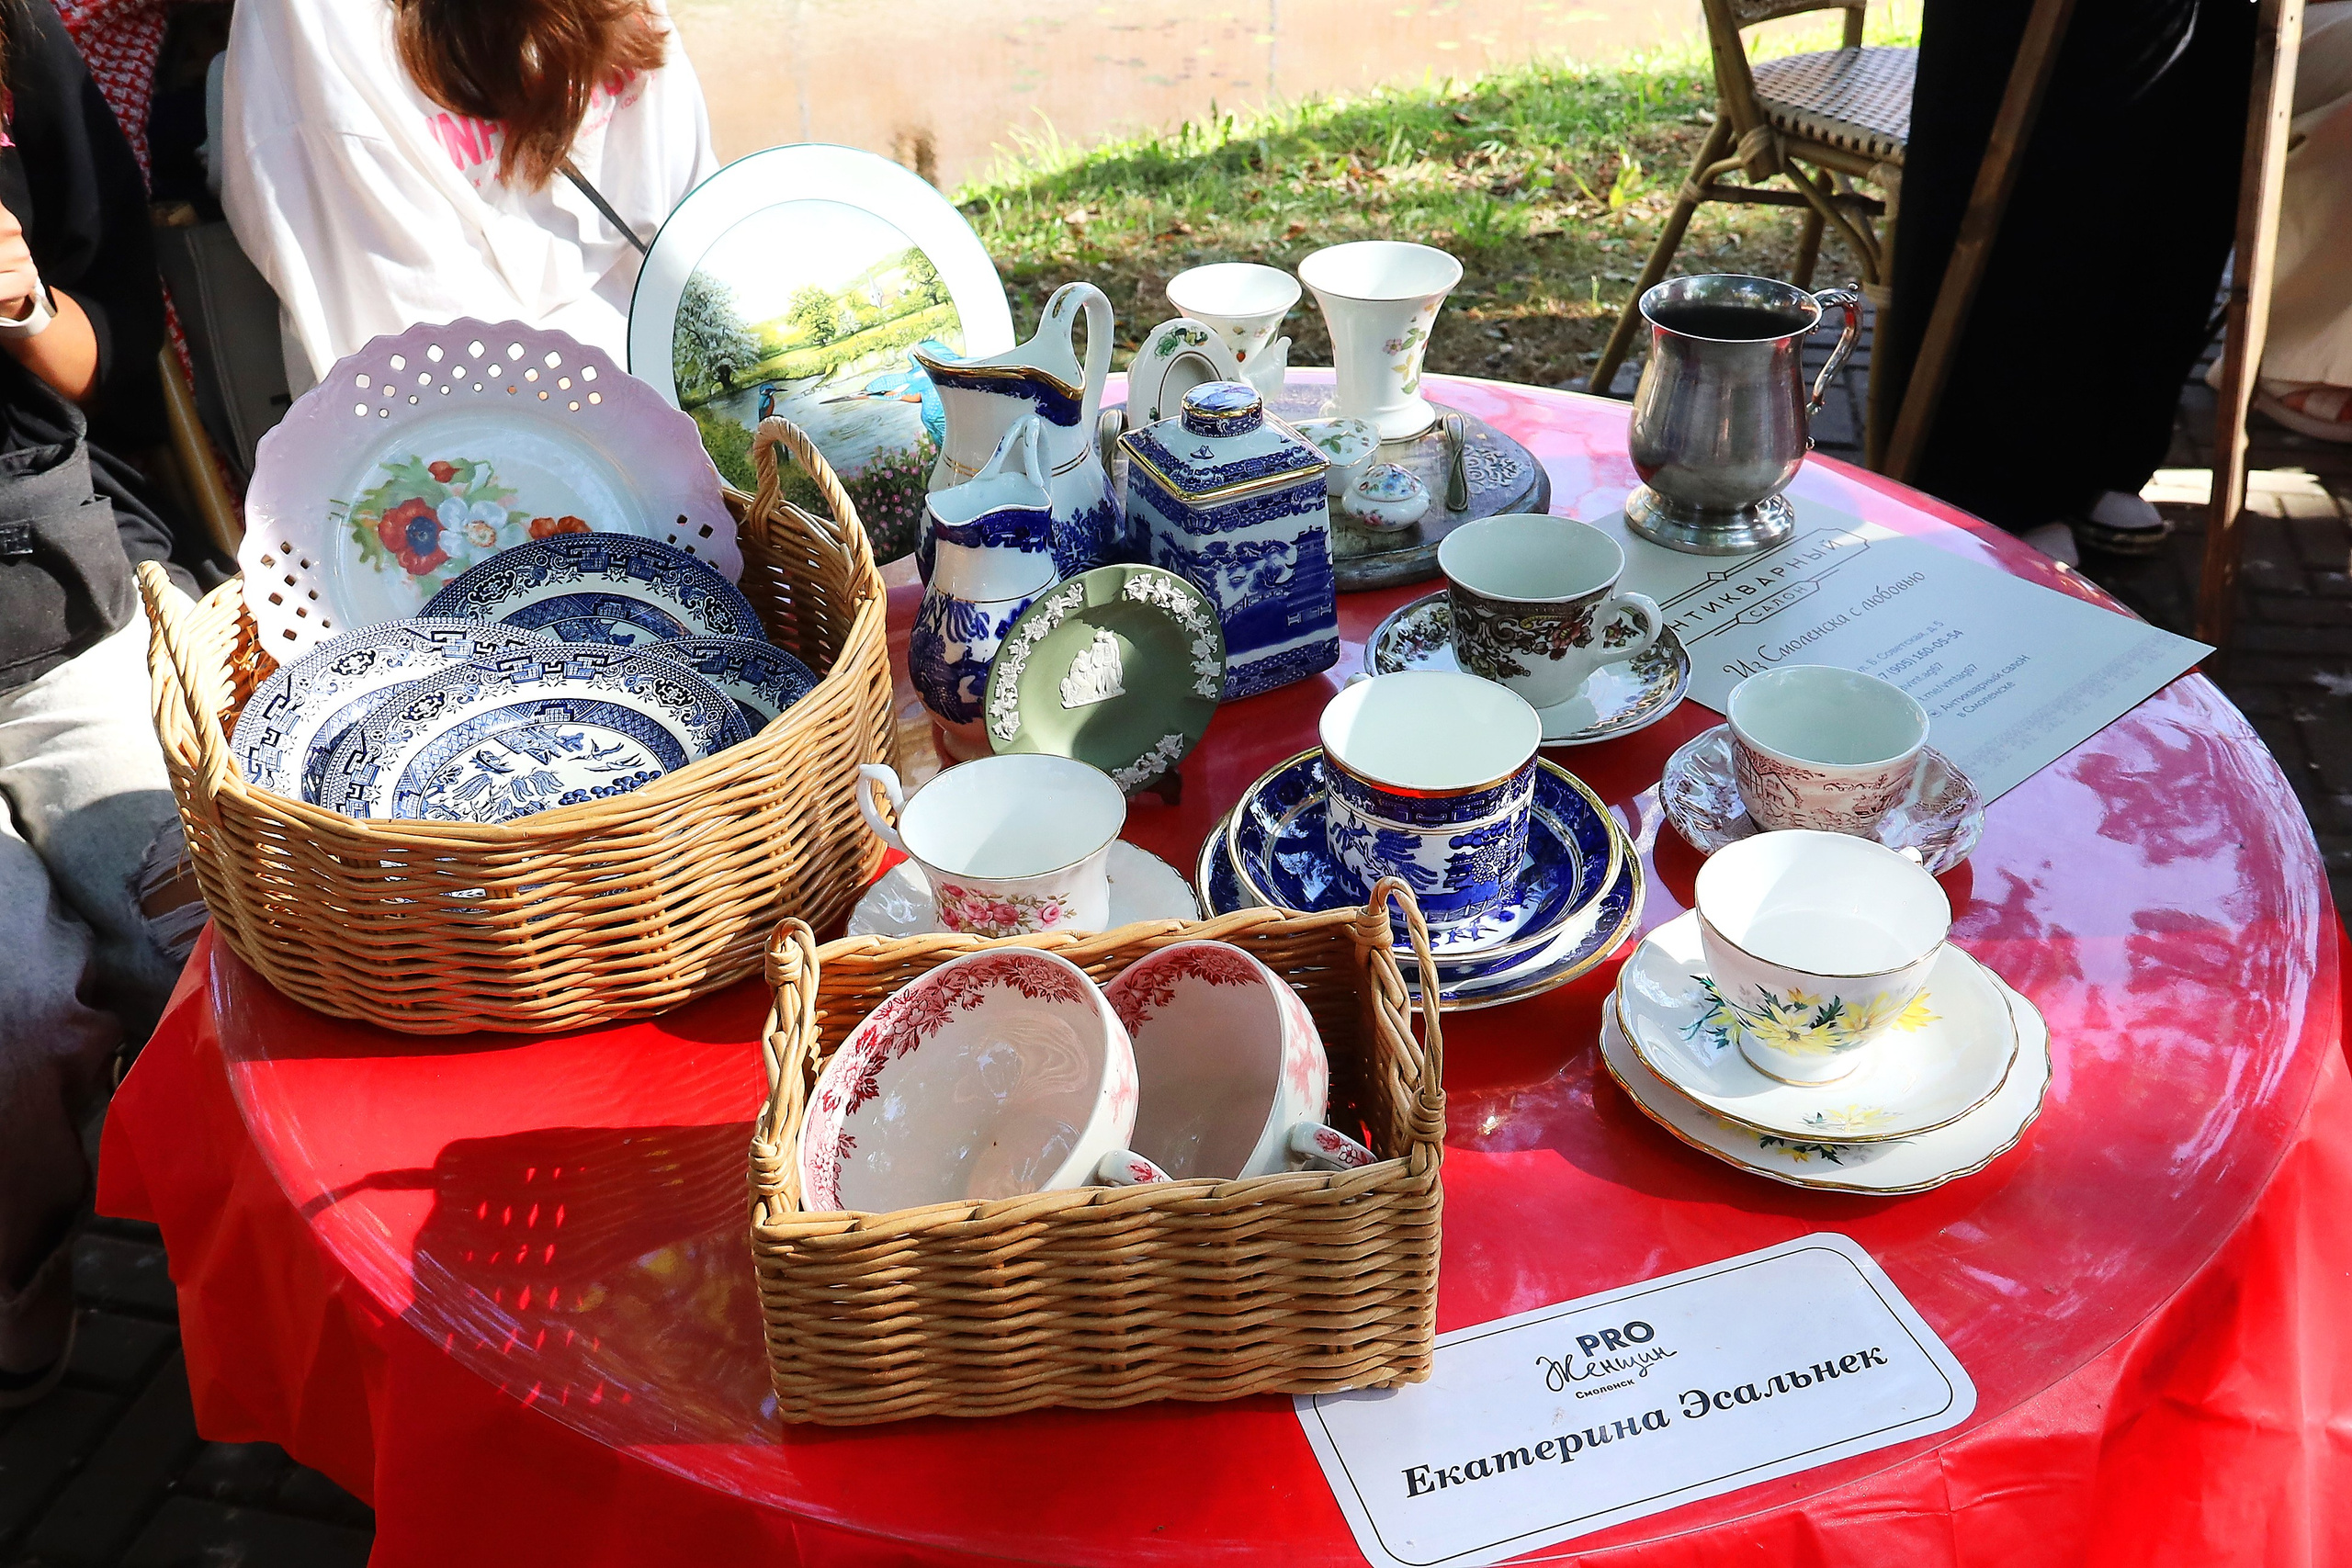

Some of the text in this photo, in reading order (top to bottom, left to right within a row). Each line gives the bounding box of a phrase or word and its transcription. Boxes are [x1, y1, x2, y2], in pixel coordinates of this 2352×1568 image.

[1668, 539, 1843, 632] НТИКВАРНЫЙ
[1749, 586, 1807, 617] САЛОН
[1723, 571, 1925, 679] Из Смоленска с любовью
[1887, 658, 1917, 675] (905)
[1912, 629, 1964, 660] 160-05-54
[1939, 671, 2003, 712] Антикварный
[1962, 681, 2016, 714] Смоленске
[1575, 1321, 1655, 1358] PRO
[1535, 1347, 1678, 1392] Женщин
[1401, 1346, 1888, 1498] Екатерина Эсальнек
